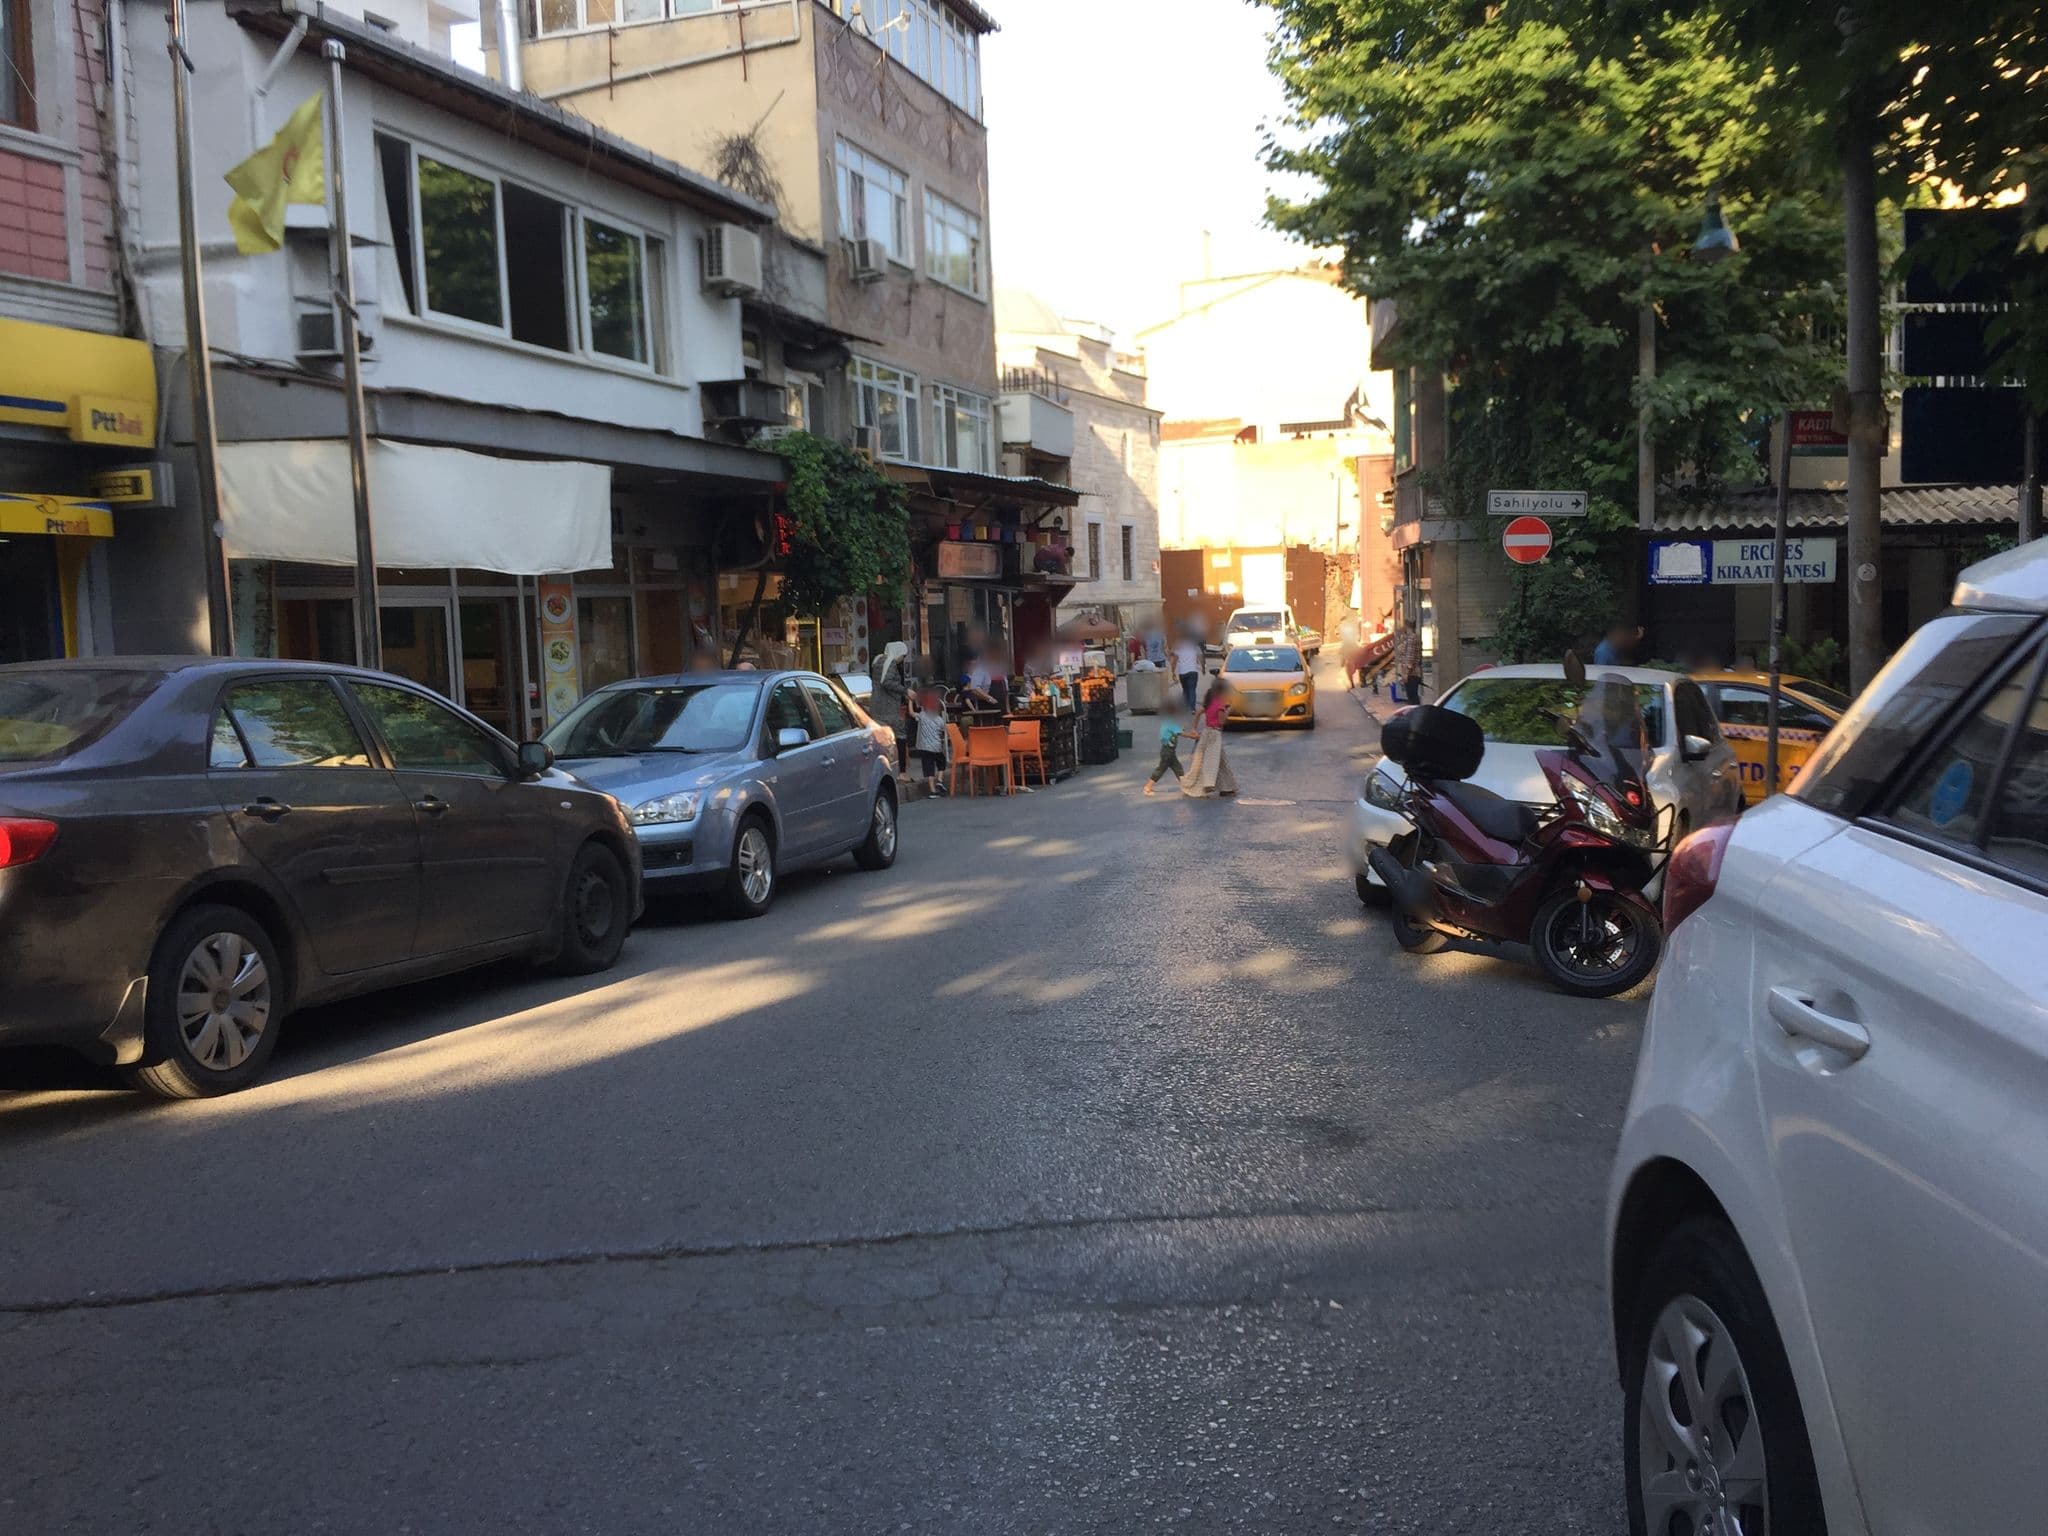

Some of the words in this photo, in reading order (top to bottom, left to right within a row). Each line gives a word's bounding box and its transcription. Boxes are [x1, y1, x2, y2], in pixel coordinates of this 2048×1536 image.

[1798, 417, 1832, 432] KADI
[1494, 496, 1563, 511] Sahilyolu
[1740, 542, 1804, 561] ERCİES
[1717, 562, 1826, 579] KIRAATANESİ
[1372, 640, 1394, 656] CLU
